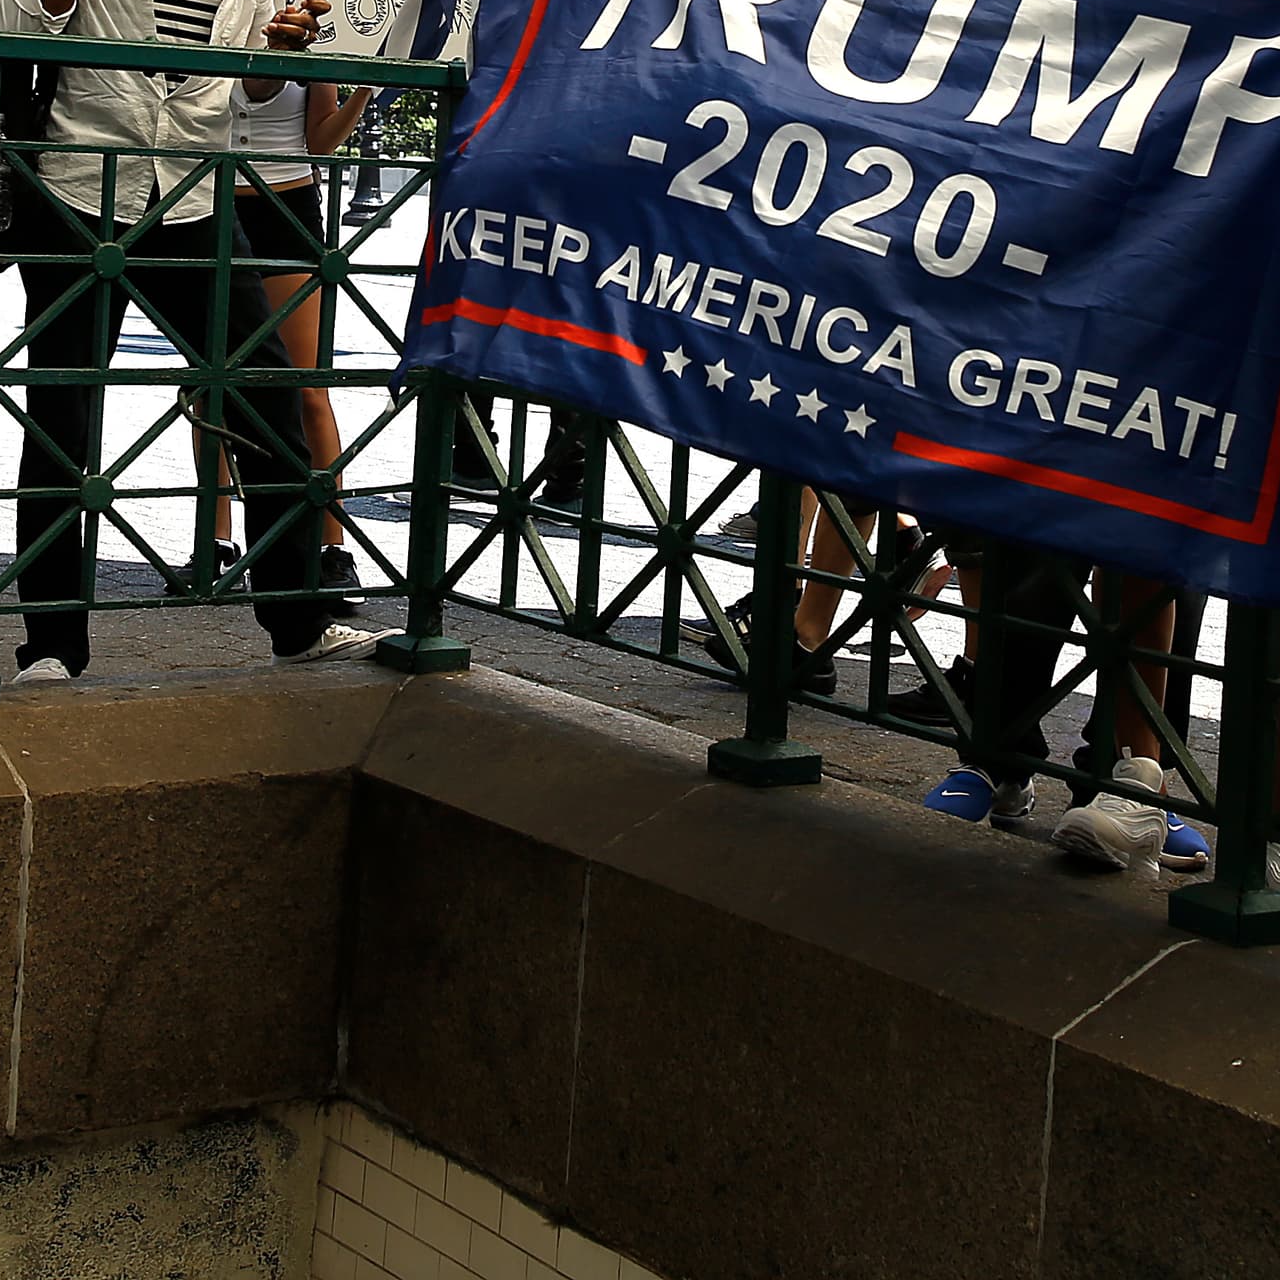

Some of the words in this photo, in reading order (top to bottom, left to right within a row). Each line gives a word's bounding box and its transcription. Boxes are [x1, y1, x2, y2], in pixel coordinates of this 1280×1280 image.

[439, 207, 590, 277] KEEP
[596, 244, 917, 388] AMERICA
[948, 349, 1237, 470] GREAT!
